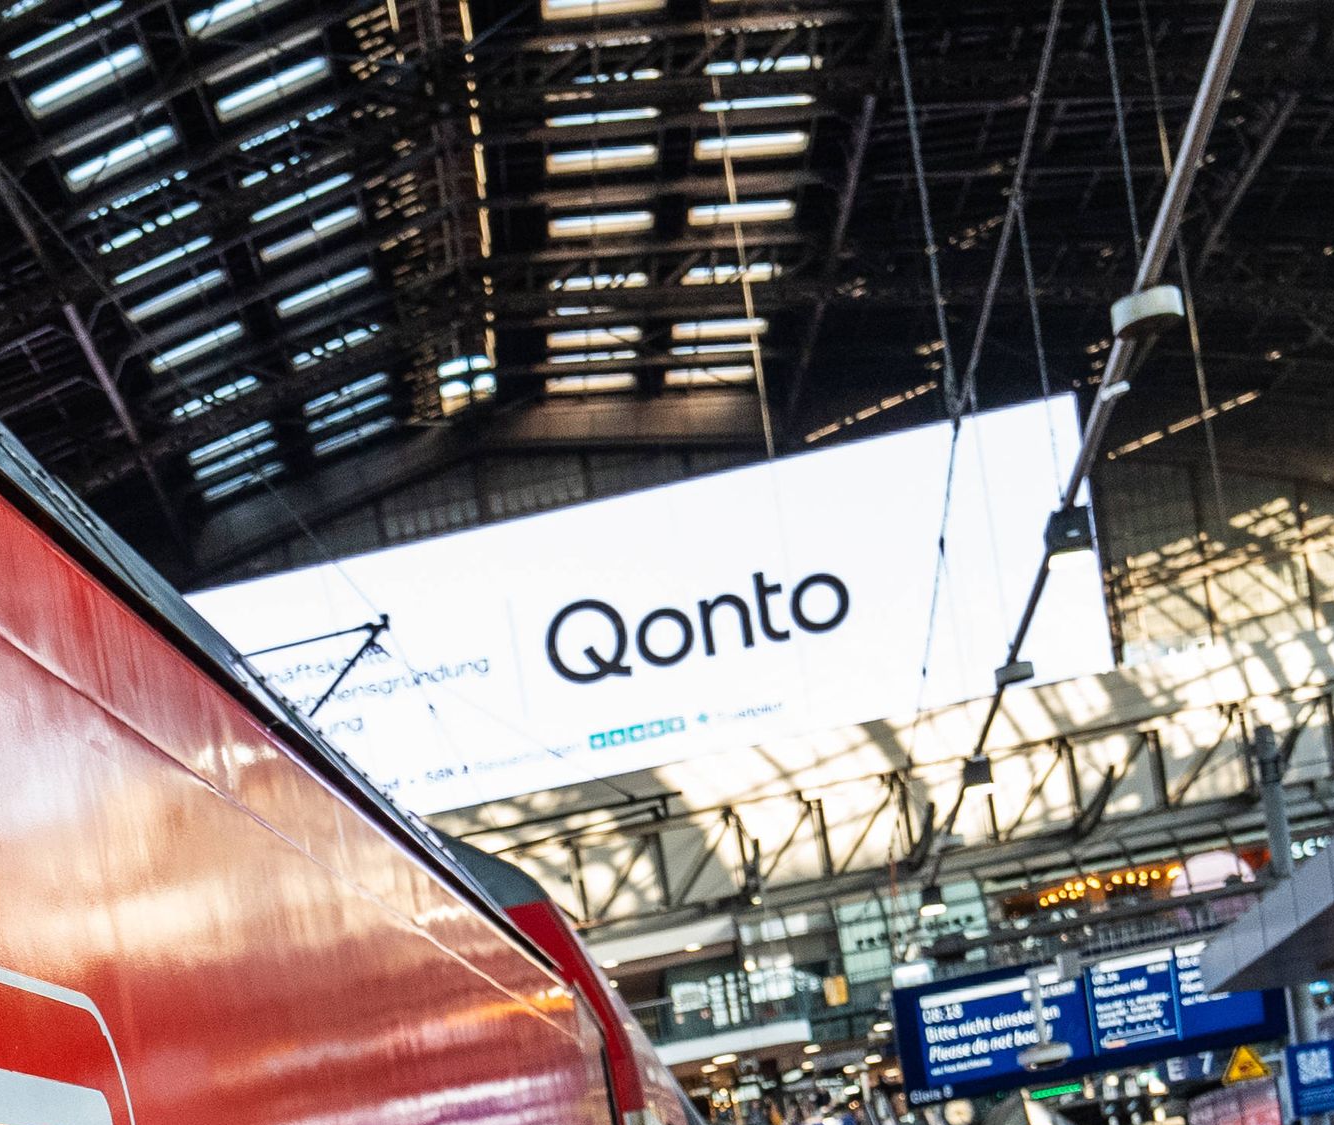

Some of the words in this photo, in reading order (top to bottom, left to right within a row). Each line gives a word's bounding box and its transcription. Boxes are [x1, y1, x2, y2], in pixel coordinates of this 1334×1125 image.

[546, 572, 850, 683] Qonto
[925, 1025, 958, 1044] Bitte
[959, 1017, 992, 1037] nicht
[929, 1045, 971, 1063] Please
[971, 1037, 990, 1055] do
[990, 1033, 1014, 1051] not
[1167, 1056, 1186, 1082] E
[1198, 1051, 1214, 1075] 7
